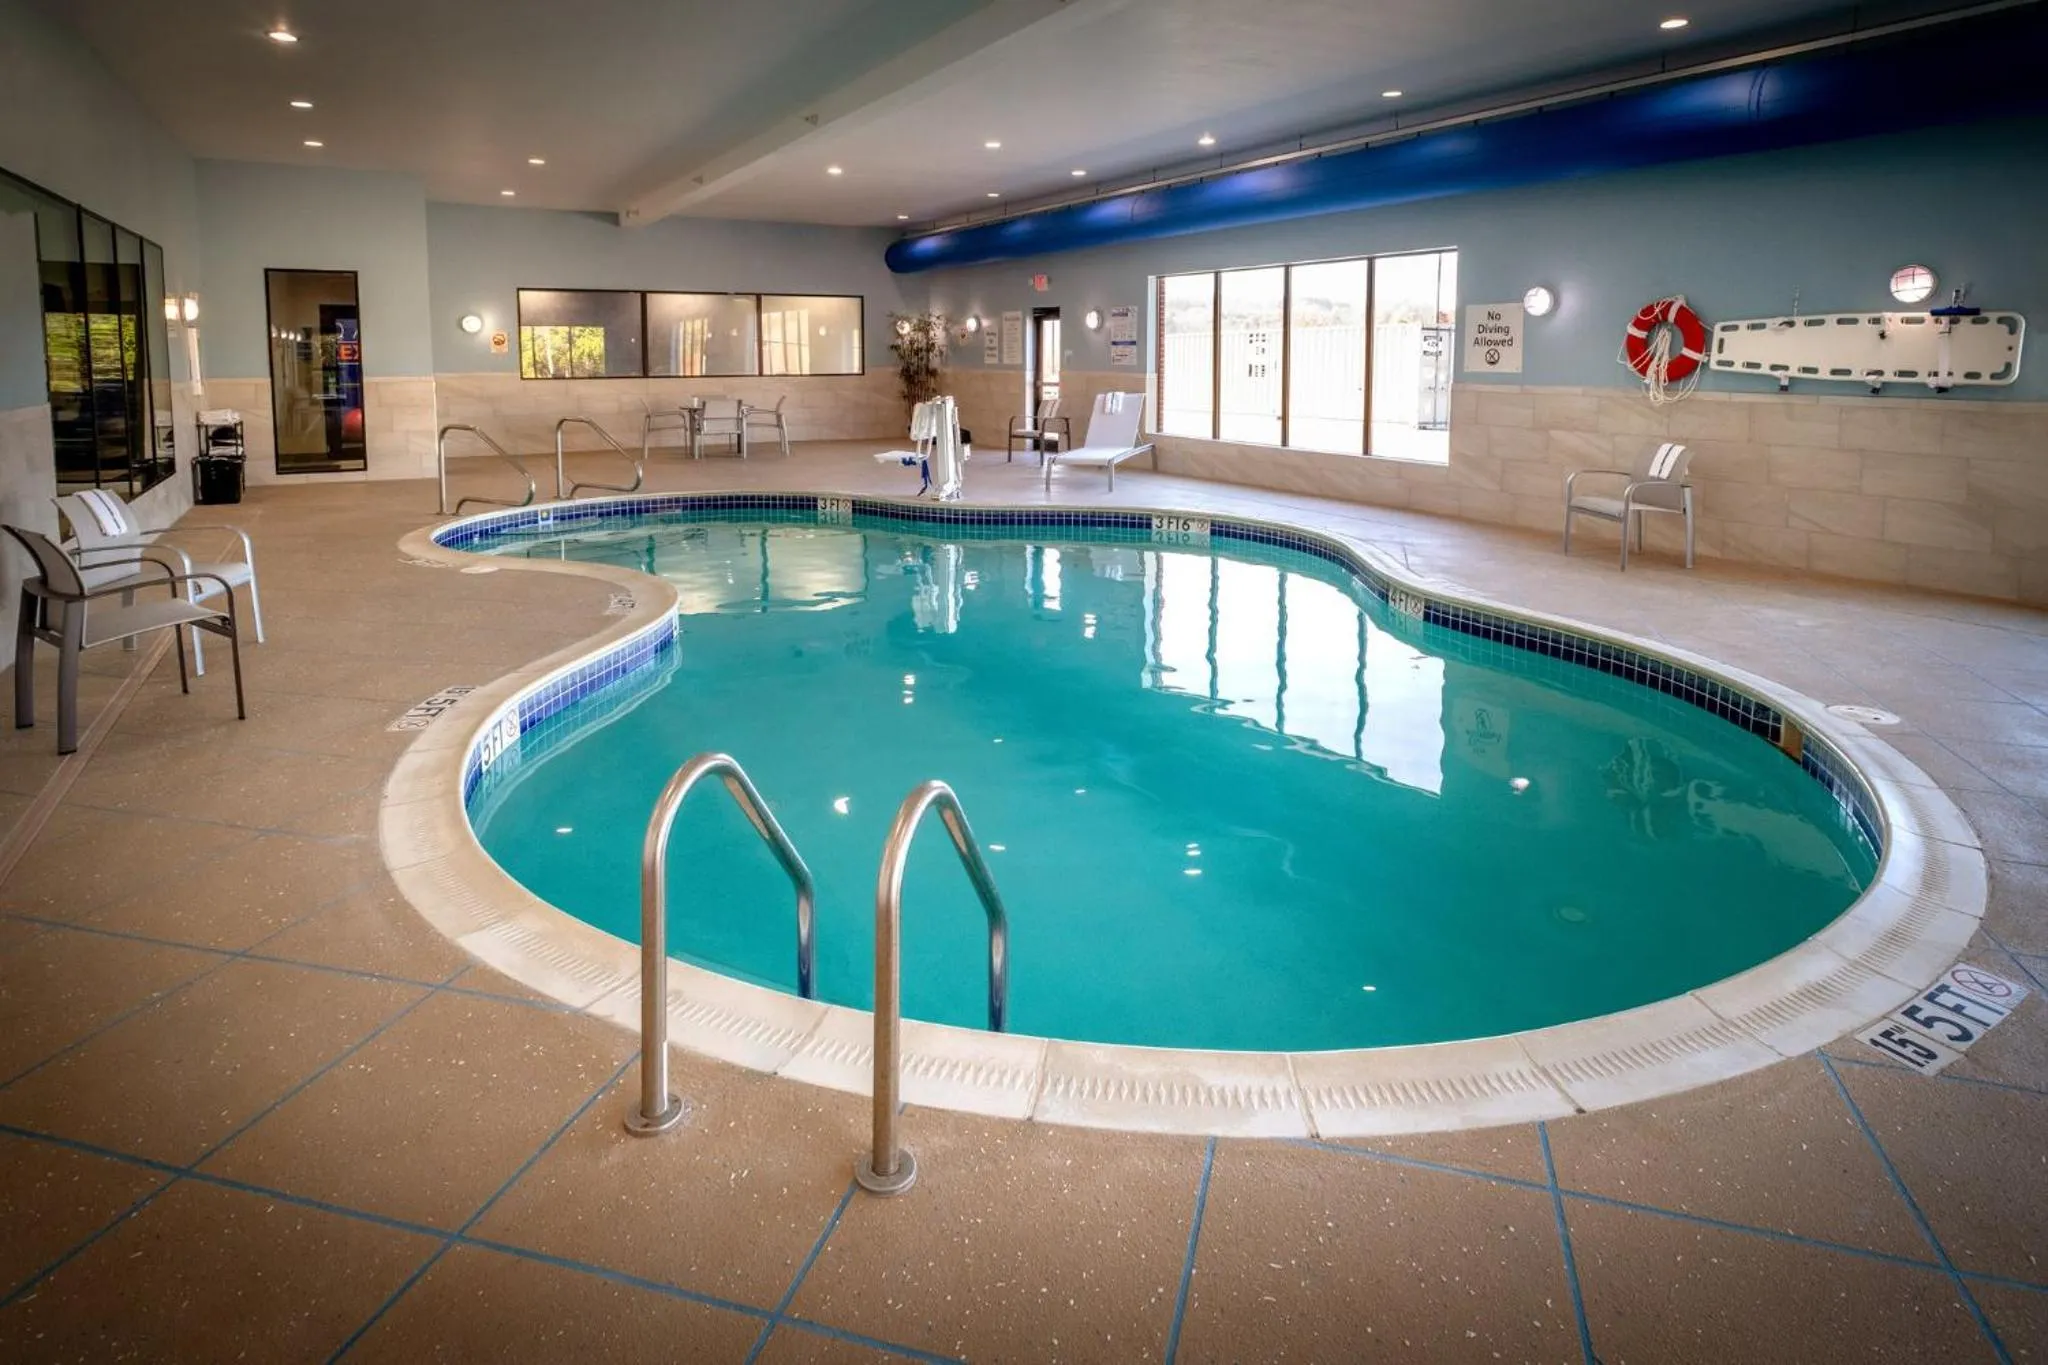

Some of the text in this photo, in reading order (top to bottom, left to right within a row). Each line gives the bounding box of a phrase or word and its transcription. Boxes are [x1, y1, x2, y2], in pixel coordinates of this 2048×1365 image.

[1486, 310, 1502, 321] No
[1478, 323, 1511, 337] Diving
[1473, 336, 1514, 348] Allowed
